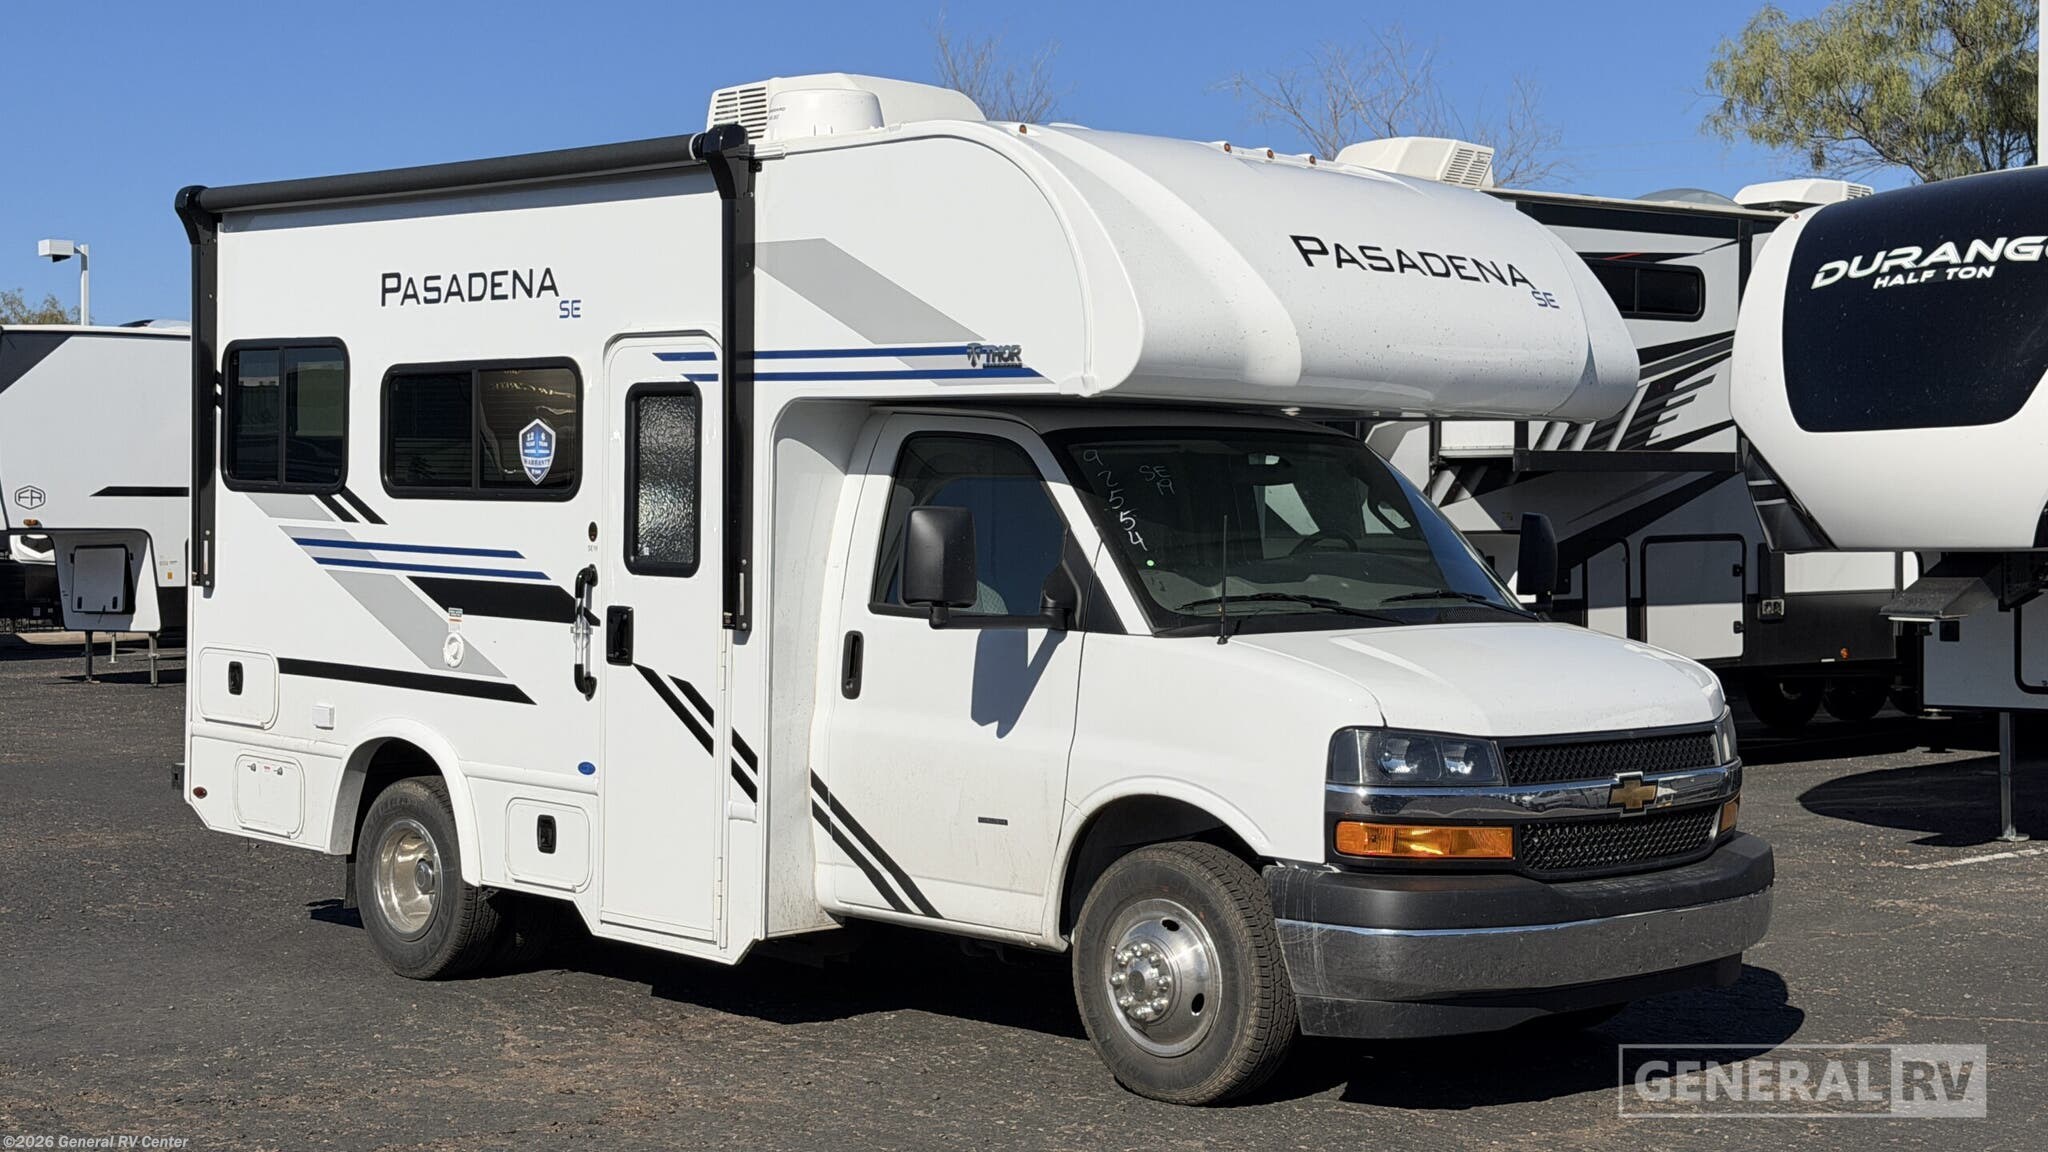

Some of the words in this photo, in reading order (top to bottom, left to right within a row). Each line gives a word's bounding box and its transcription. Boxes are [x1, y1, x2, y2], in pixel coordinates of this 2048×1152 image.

[1289, 235, 1536, 290] PASADENA
[1531, 291, 1560, 309] SE
[1811, 236, 2048, 290] DURANG
[1873, 269, 1936, 290] HALF
[1946, 265, 1996, 281] TON
[381, 267, 560, 307] PASADENA
[559, 299, 582, 319] SE
[983, 344, 1022, 363] THOR
[1083, 449, 1148, 552] 92554
